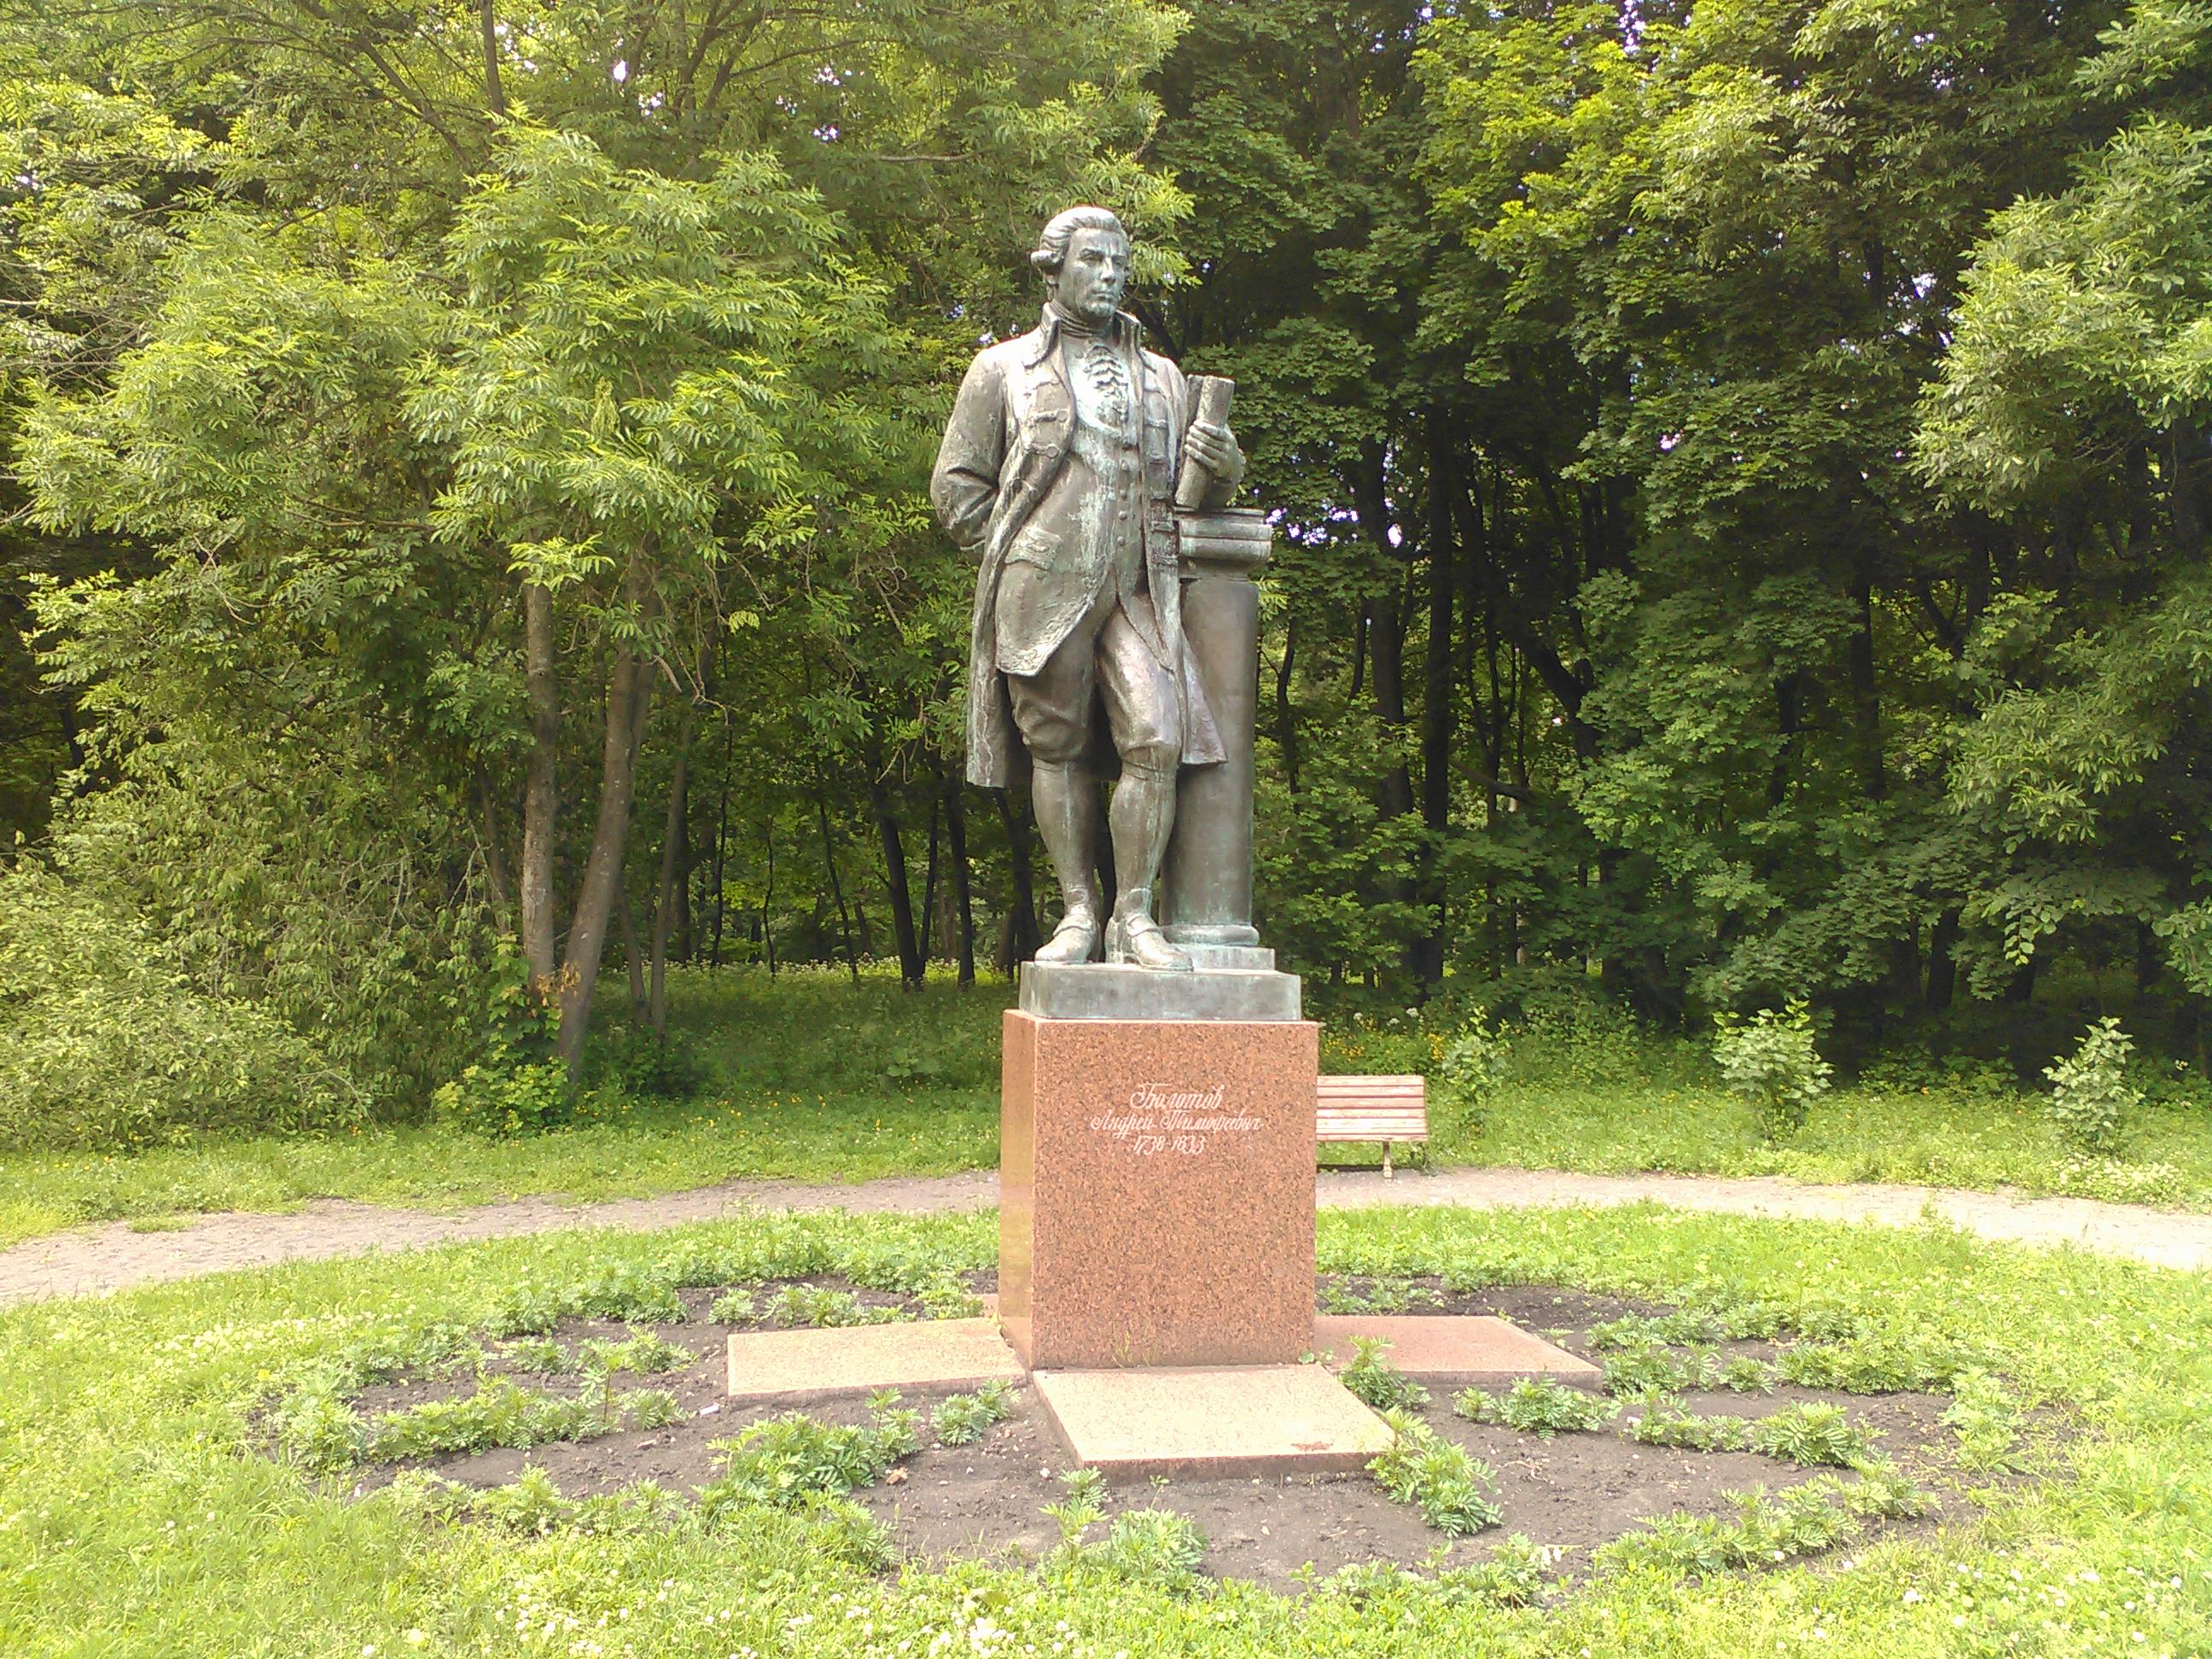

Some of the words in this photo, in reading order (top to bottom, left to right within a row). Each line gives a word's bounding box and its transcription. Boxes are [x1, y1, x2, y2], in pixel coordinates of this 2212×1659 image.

[1130, 1083, 1225, 1109] Болотов
[1091, 1109, 1157, 1139] Андрей
[1160, 1108, 1263, 1133] Тимофеевич
